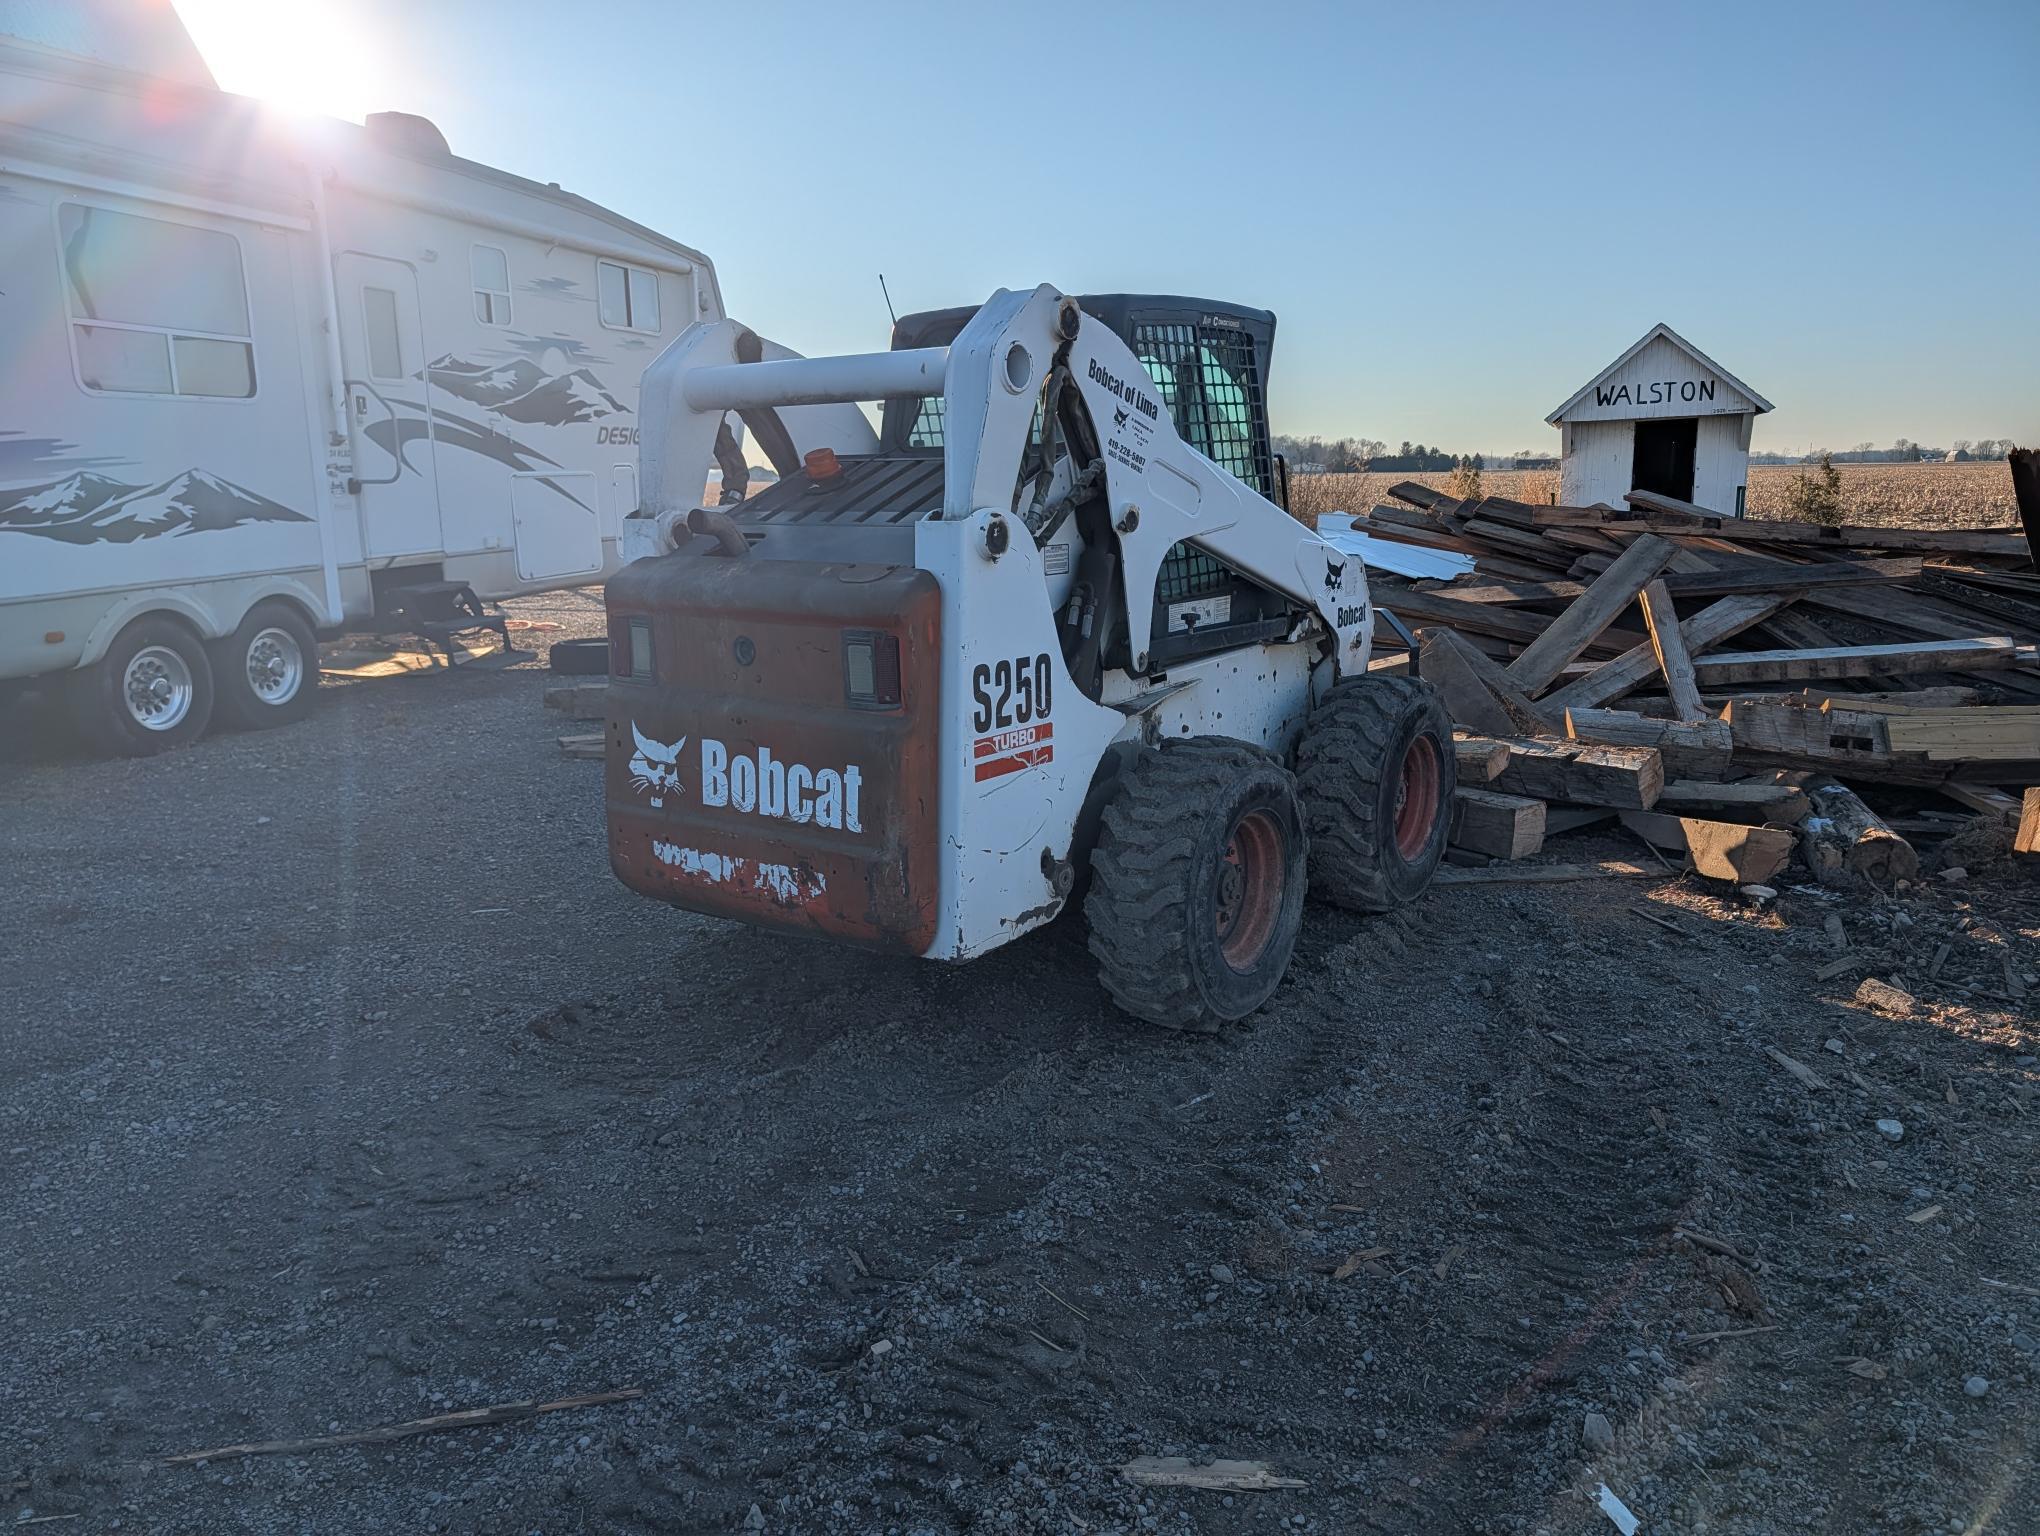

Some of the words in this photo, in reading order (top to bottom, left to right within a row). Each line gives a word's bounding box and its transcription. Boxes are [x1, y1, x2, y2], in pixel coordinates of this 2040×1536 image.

[1088, 357, 1124, 400] Bobcat
[1124, 386, 1136, 406] of
[1135, 390, 1159, 422] Lima
[1596, 380, 1715, 407] WALSTON
[1337, 601, 1367, 629] Bobcat
[973, 652, 1052, 734] S250
[992, 727, 1036, 752] TURBO
[701, 738, 863, 834] Bobcat
